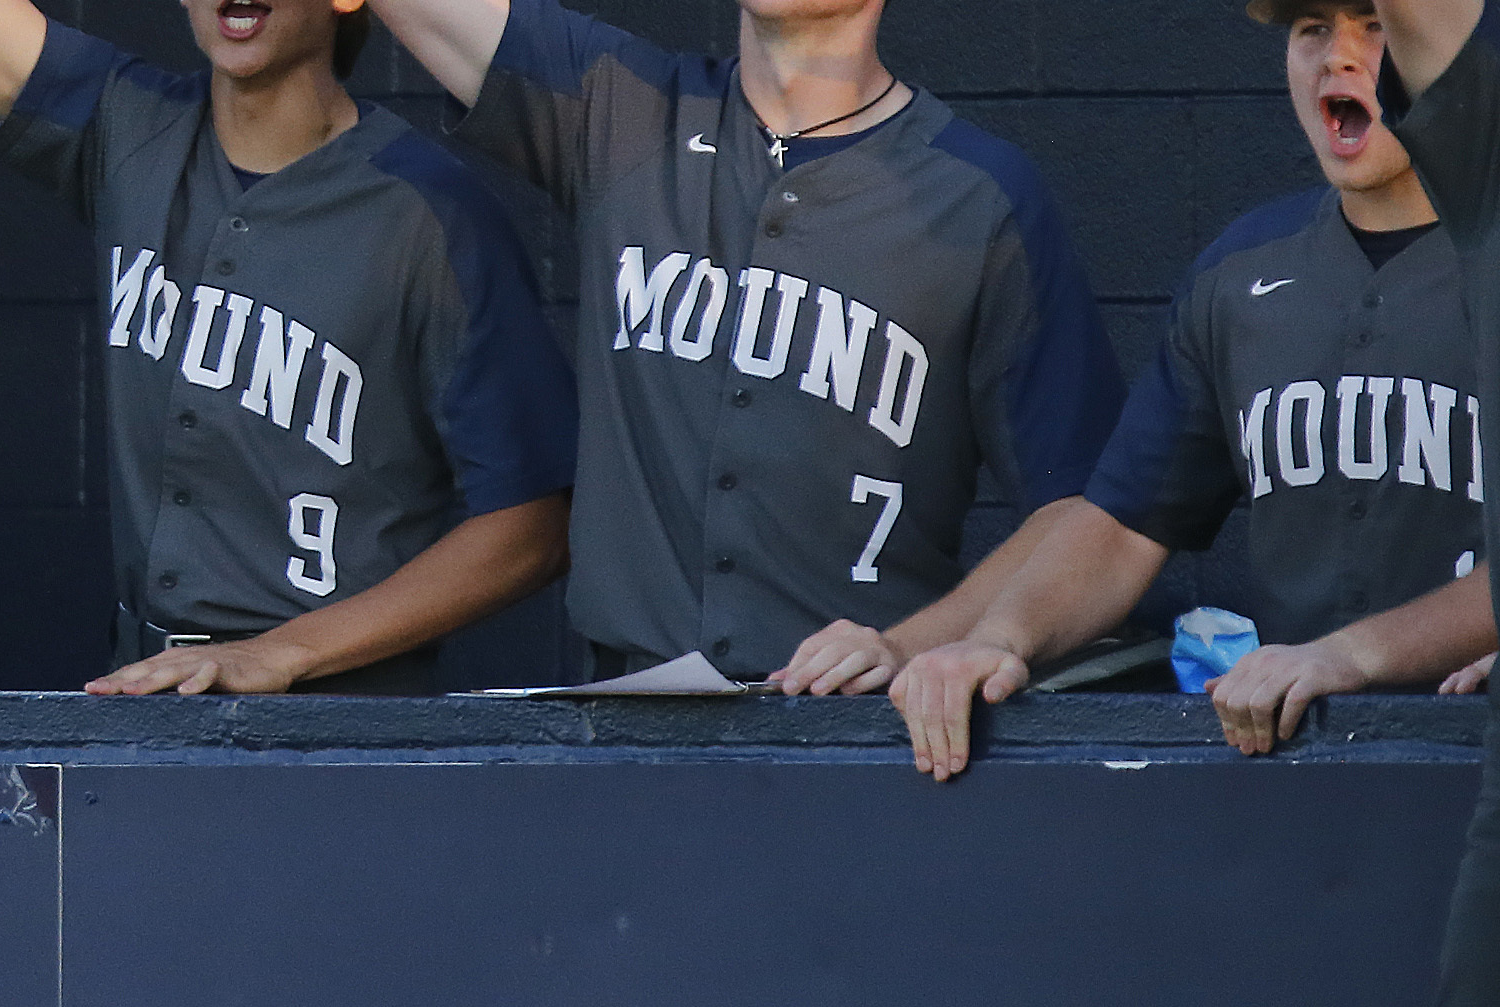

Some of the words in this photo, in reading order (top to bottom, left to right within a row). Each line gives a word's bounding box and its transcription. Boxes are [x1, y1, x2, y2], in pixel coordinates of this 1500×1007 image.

[109, 245, 364, 467] MOUND
[613, 244, 930, 449] MOUND
[285, 491, 339, 597] 9
[851, 473, 904, 583] 7
